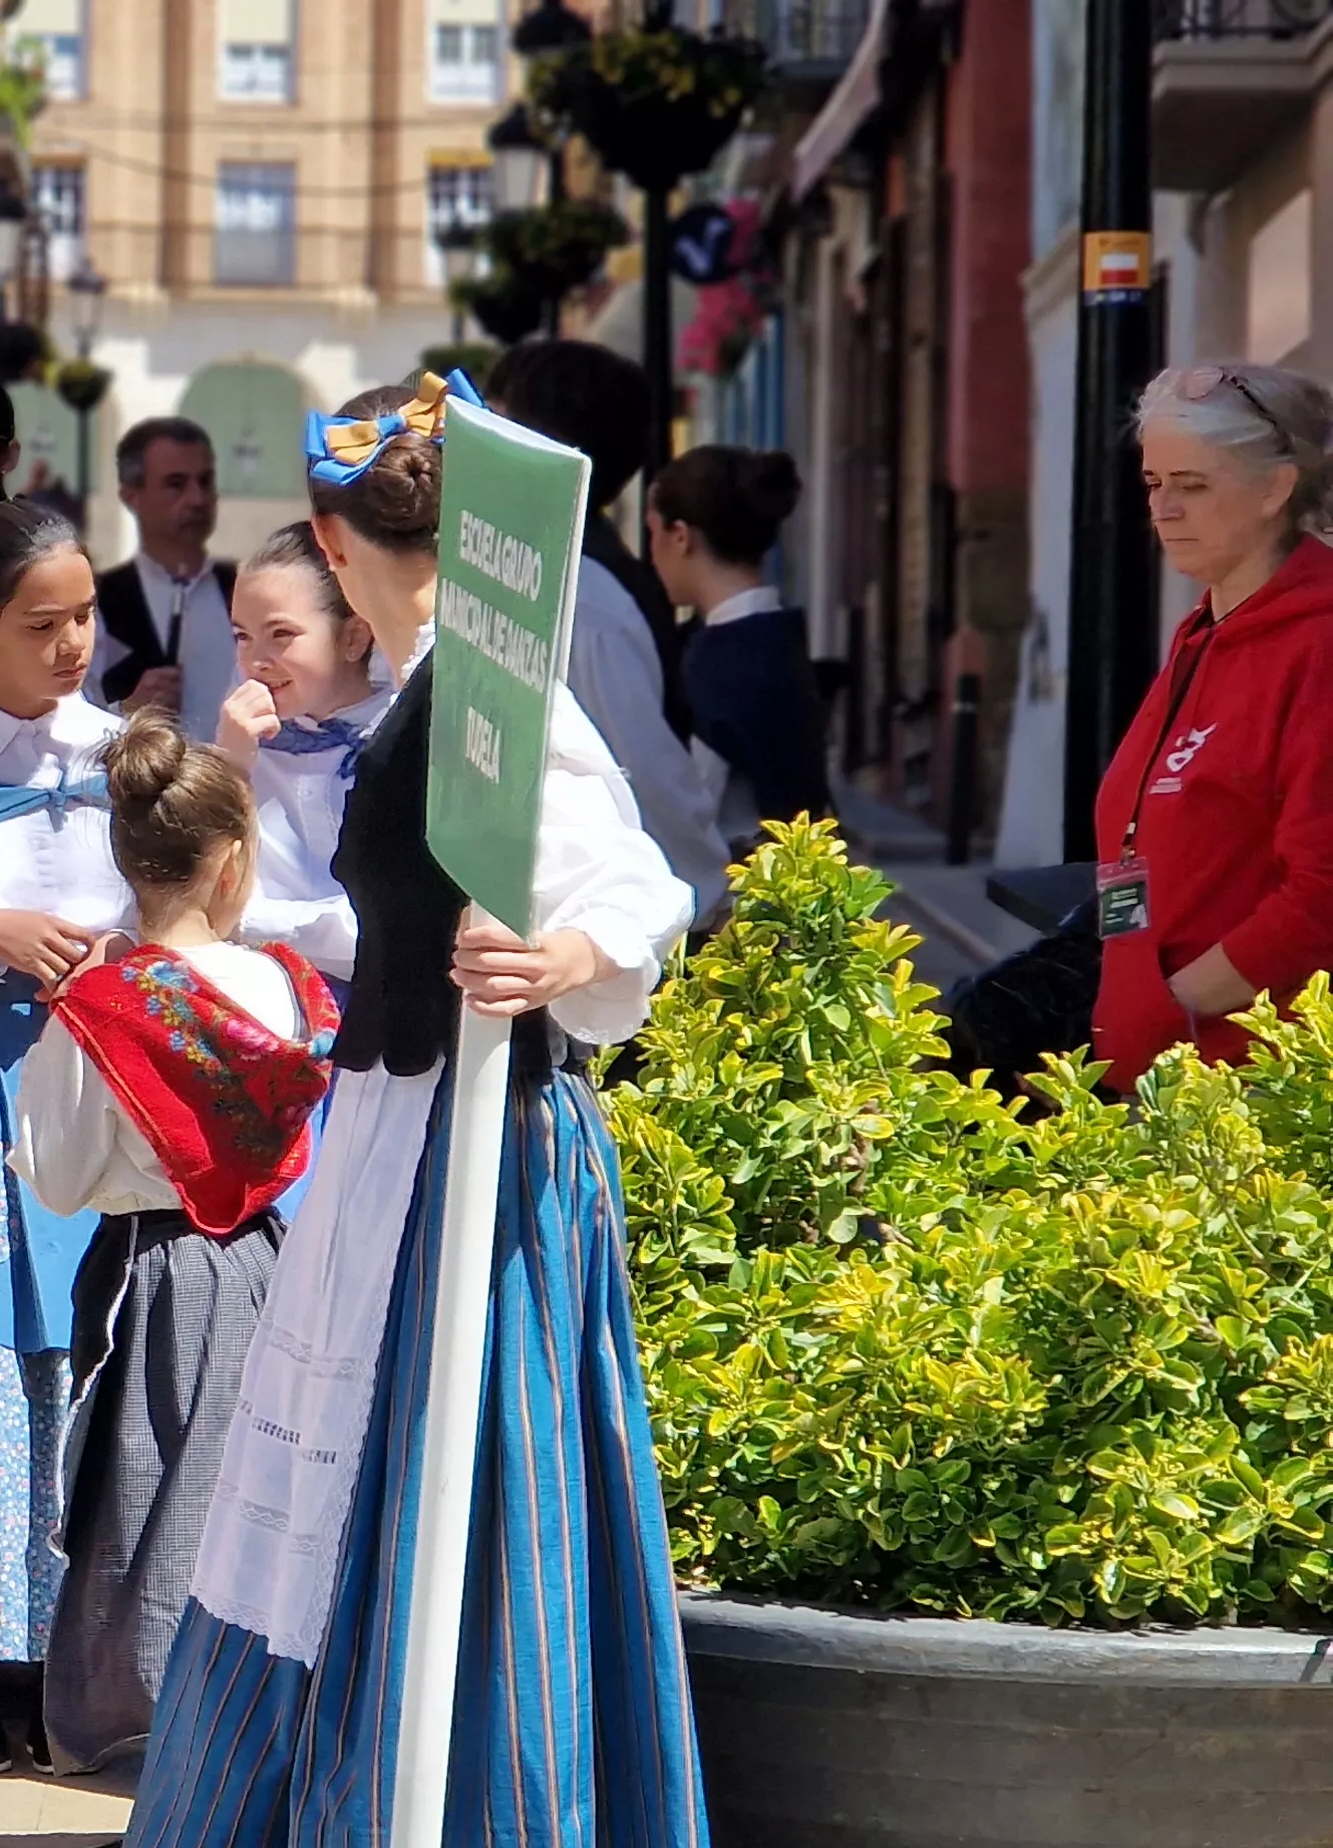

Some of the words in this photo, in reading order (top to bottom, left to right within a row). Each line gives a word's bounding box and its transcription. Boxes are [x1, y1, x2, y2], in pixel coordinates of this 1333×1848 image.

[459, 509, 502, 582] ESCUELA
[501, 534, 543, 602] GRUPO
[440, 577, 492, 658] MUNICIPAL
[465, 705, 501, 785] TUDELA
